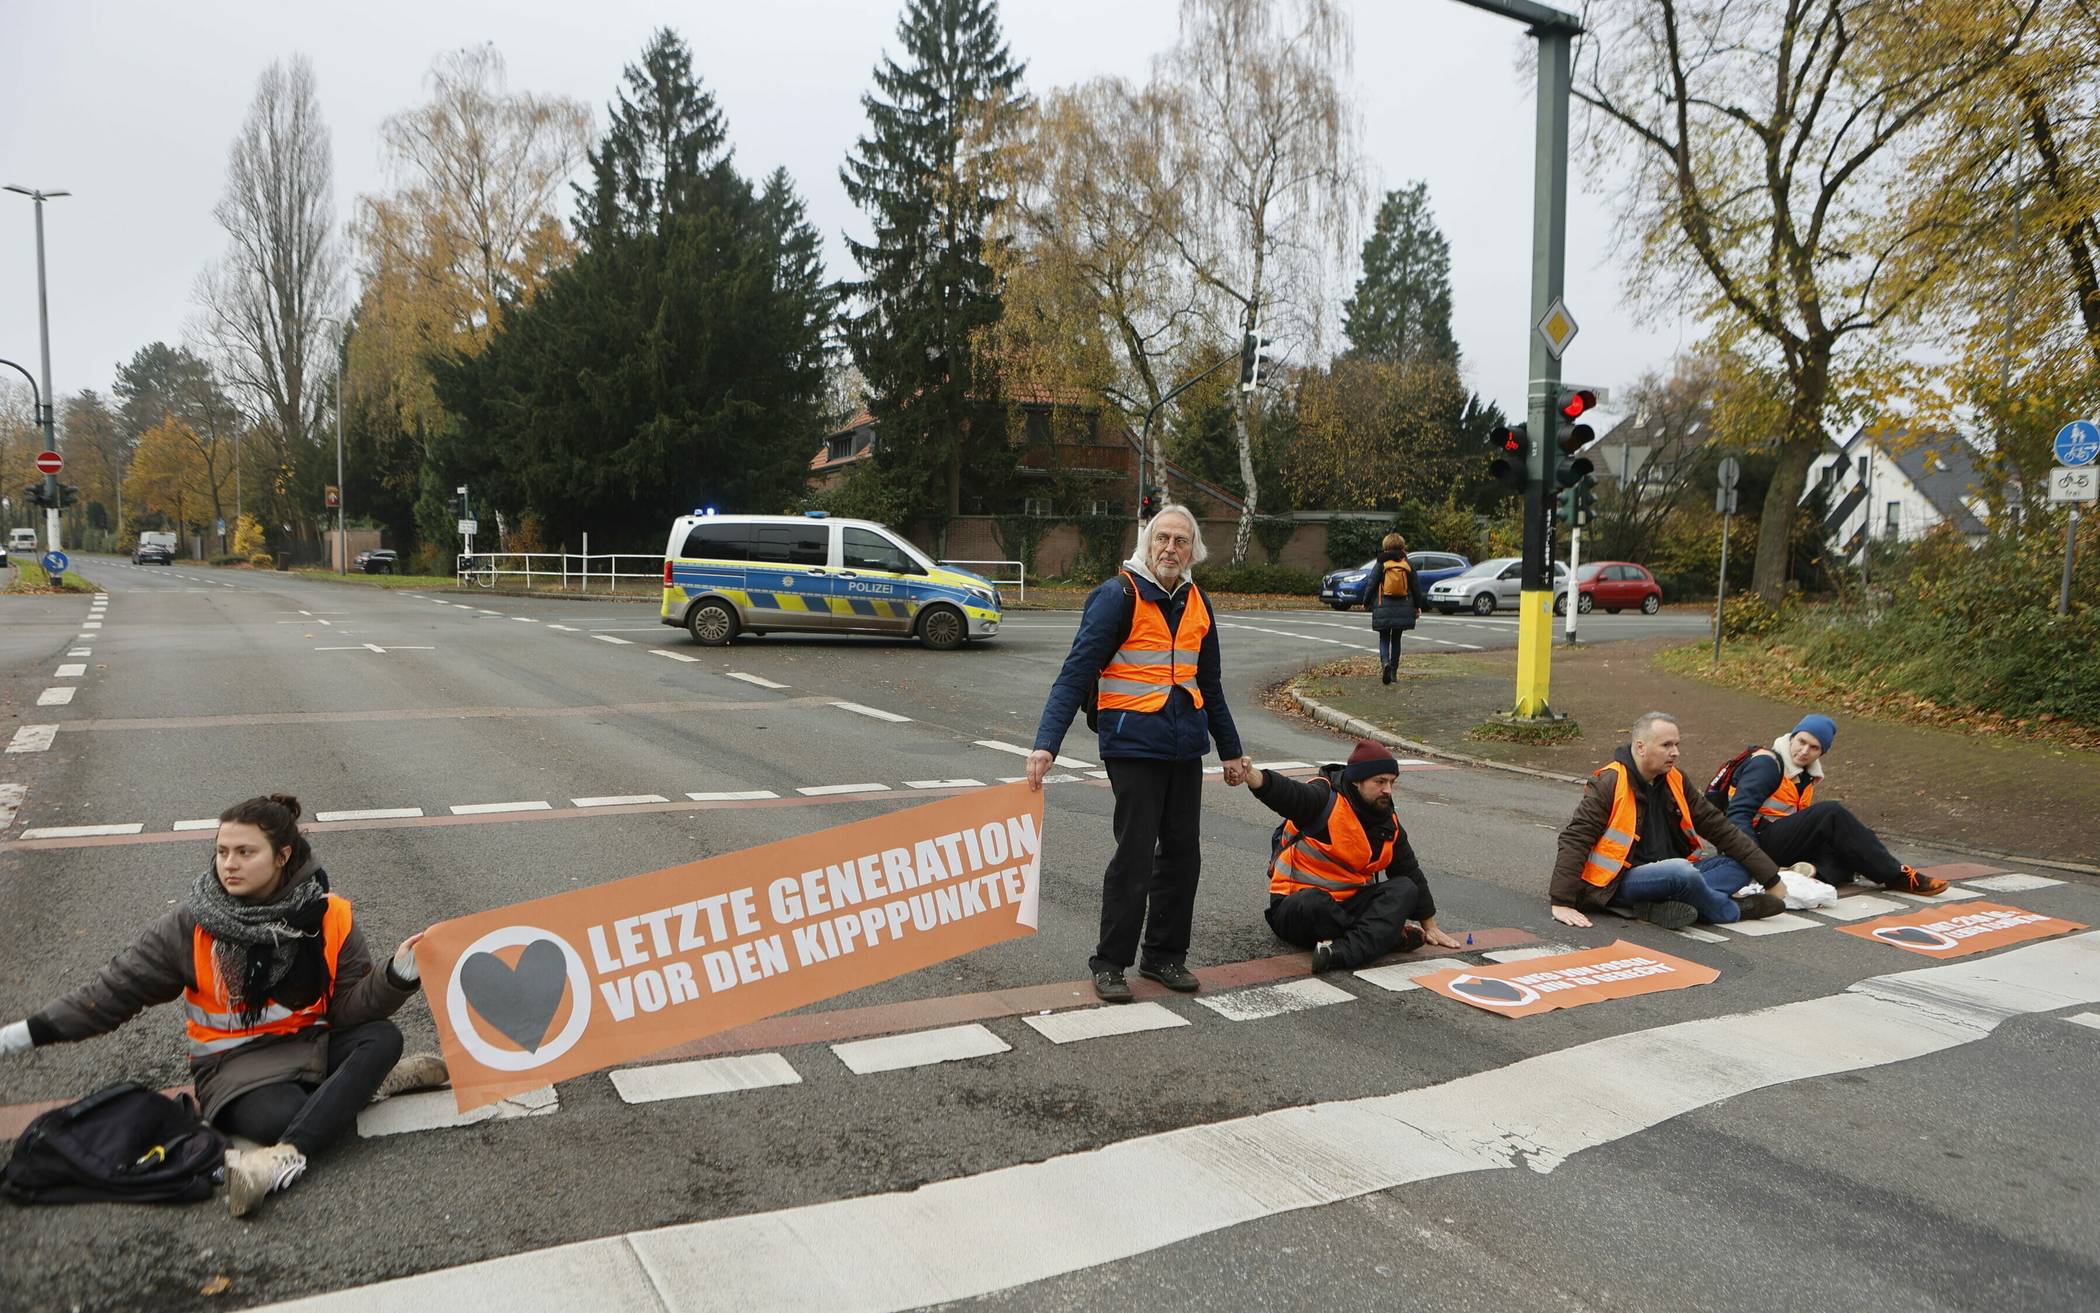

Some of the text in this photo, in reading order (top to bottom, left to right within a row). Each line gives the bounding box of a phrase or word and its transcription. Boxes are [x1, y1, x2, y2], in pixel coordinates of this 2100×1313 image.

[848, 581, 894, 594] POLIZEI
[587, 813, 1040, 975] LETZTE GENERATION
[599, 961, 700, 1022] VOR
[702, 934, 789, 993] DEN
